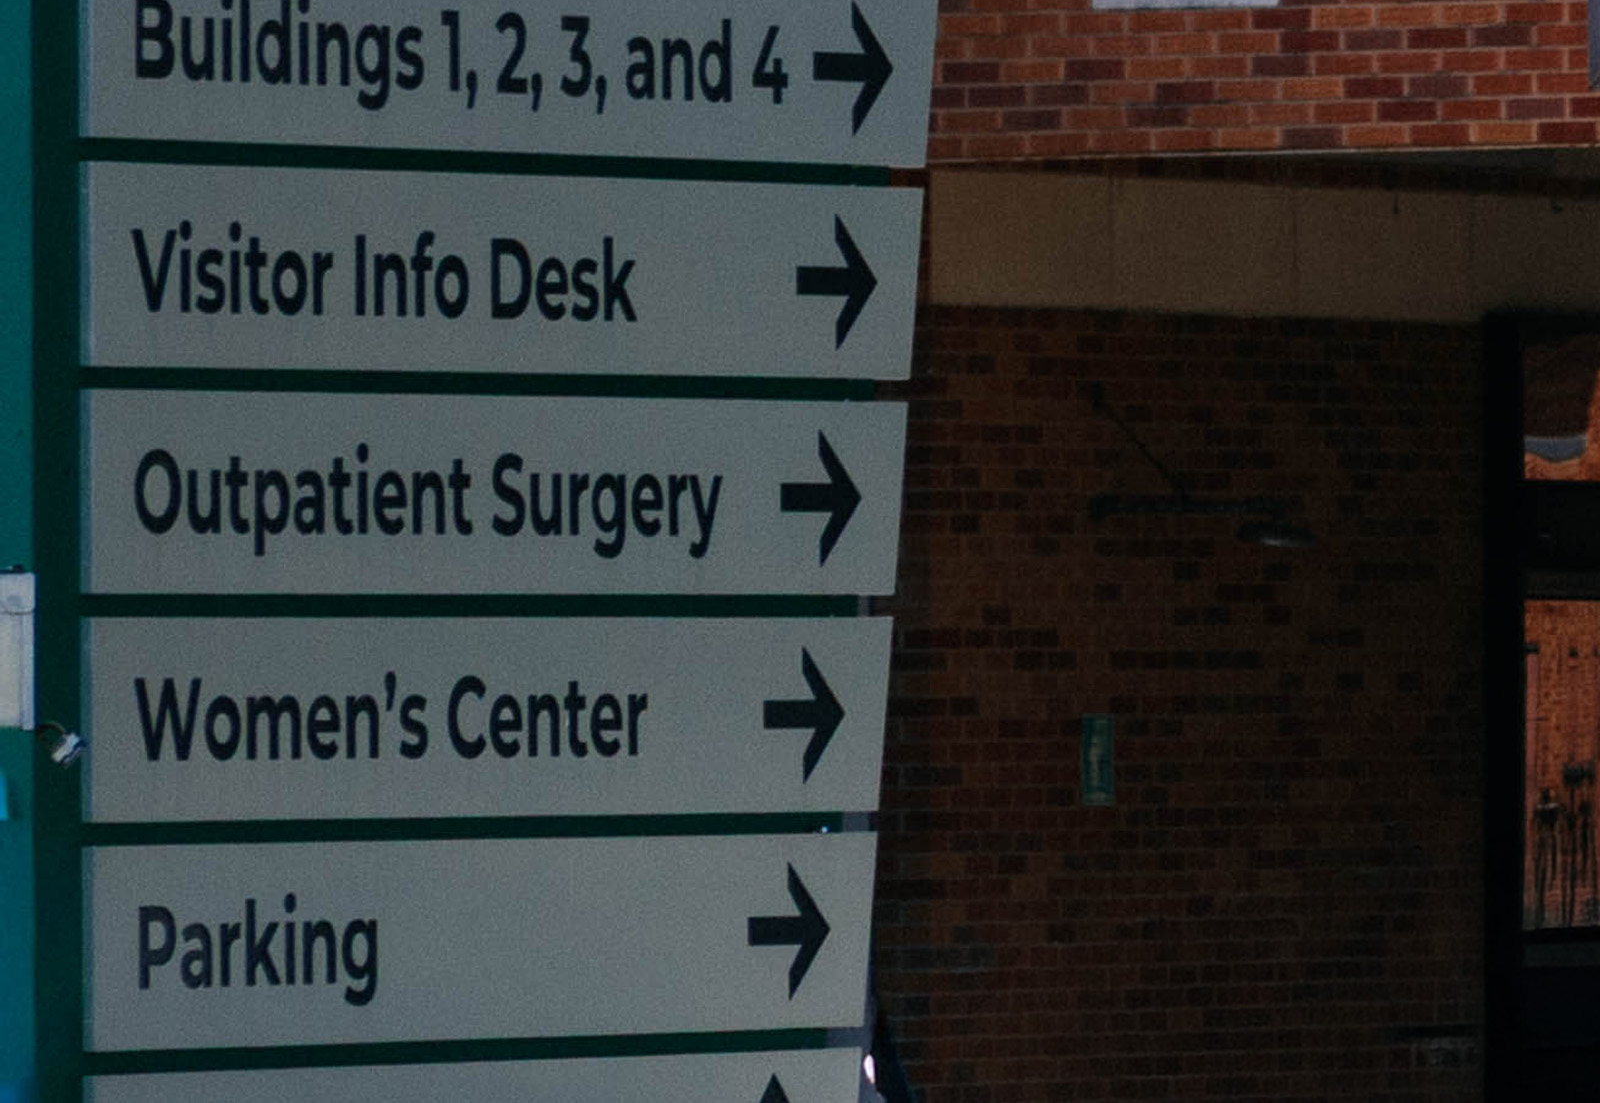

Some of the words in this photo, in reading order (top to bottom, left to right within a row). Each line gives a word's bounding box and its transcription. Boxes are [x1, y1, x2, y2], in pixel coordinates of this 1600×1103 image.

[440, 9, 479, 103] 1,
[494, 10, 544, 113] 2,
[559, 15, 607, 117] 3,
[627, 18, 733, 103] and
[752, 24, 790, 105] 4
[132, 221, 334, 315] Visitor
[354, 229, 469, 320] Info
[490, 236, 637, 324] Desk
[133, 444, 472, 557] Outpatient
[491, 453, 722, 558] Surgery
[135, 672, 429, 762] Women's
[447, 676, 648, 759] Center
[137, 894, 379, 1006] Parking
